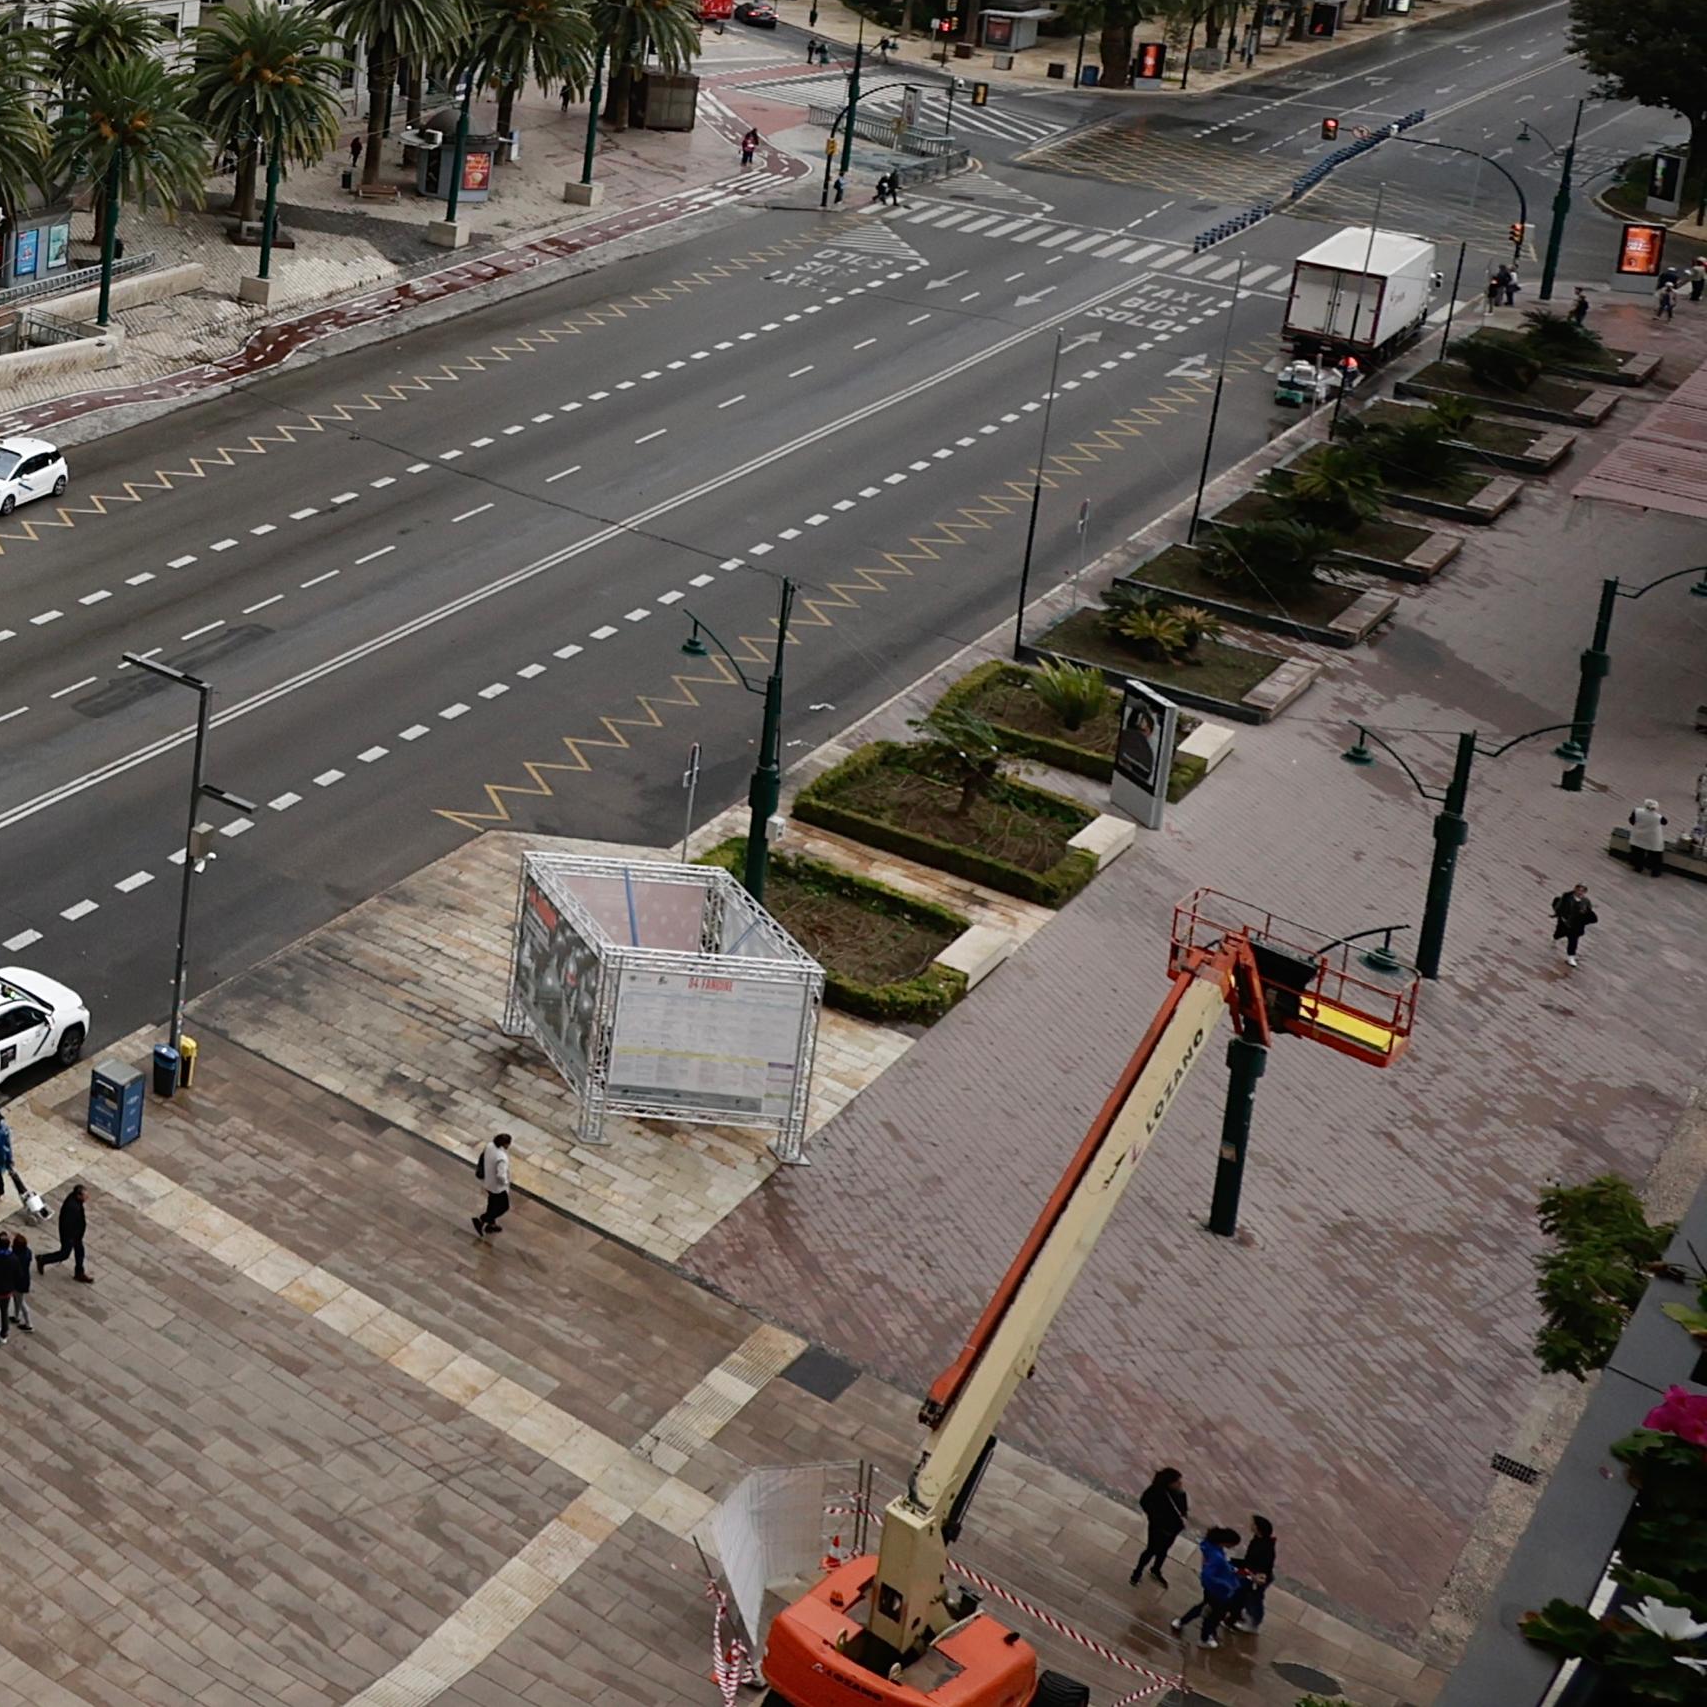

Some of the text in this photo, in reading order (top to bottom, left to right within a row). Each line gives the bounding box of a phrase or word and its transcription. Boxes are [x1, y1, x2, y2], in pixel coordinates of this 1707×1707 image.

[1119, 297, 1188, 317] BUS
[1138, 284, 1216, 307] TAXI
[1084, 306, 1176, 331] SOLO
[1145, 1028, 1204, 1134] LOZANO
